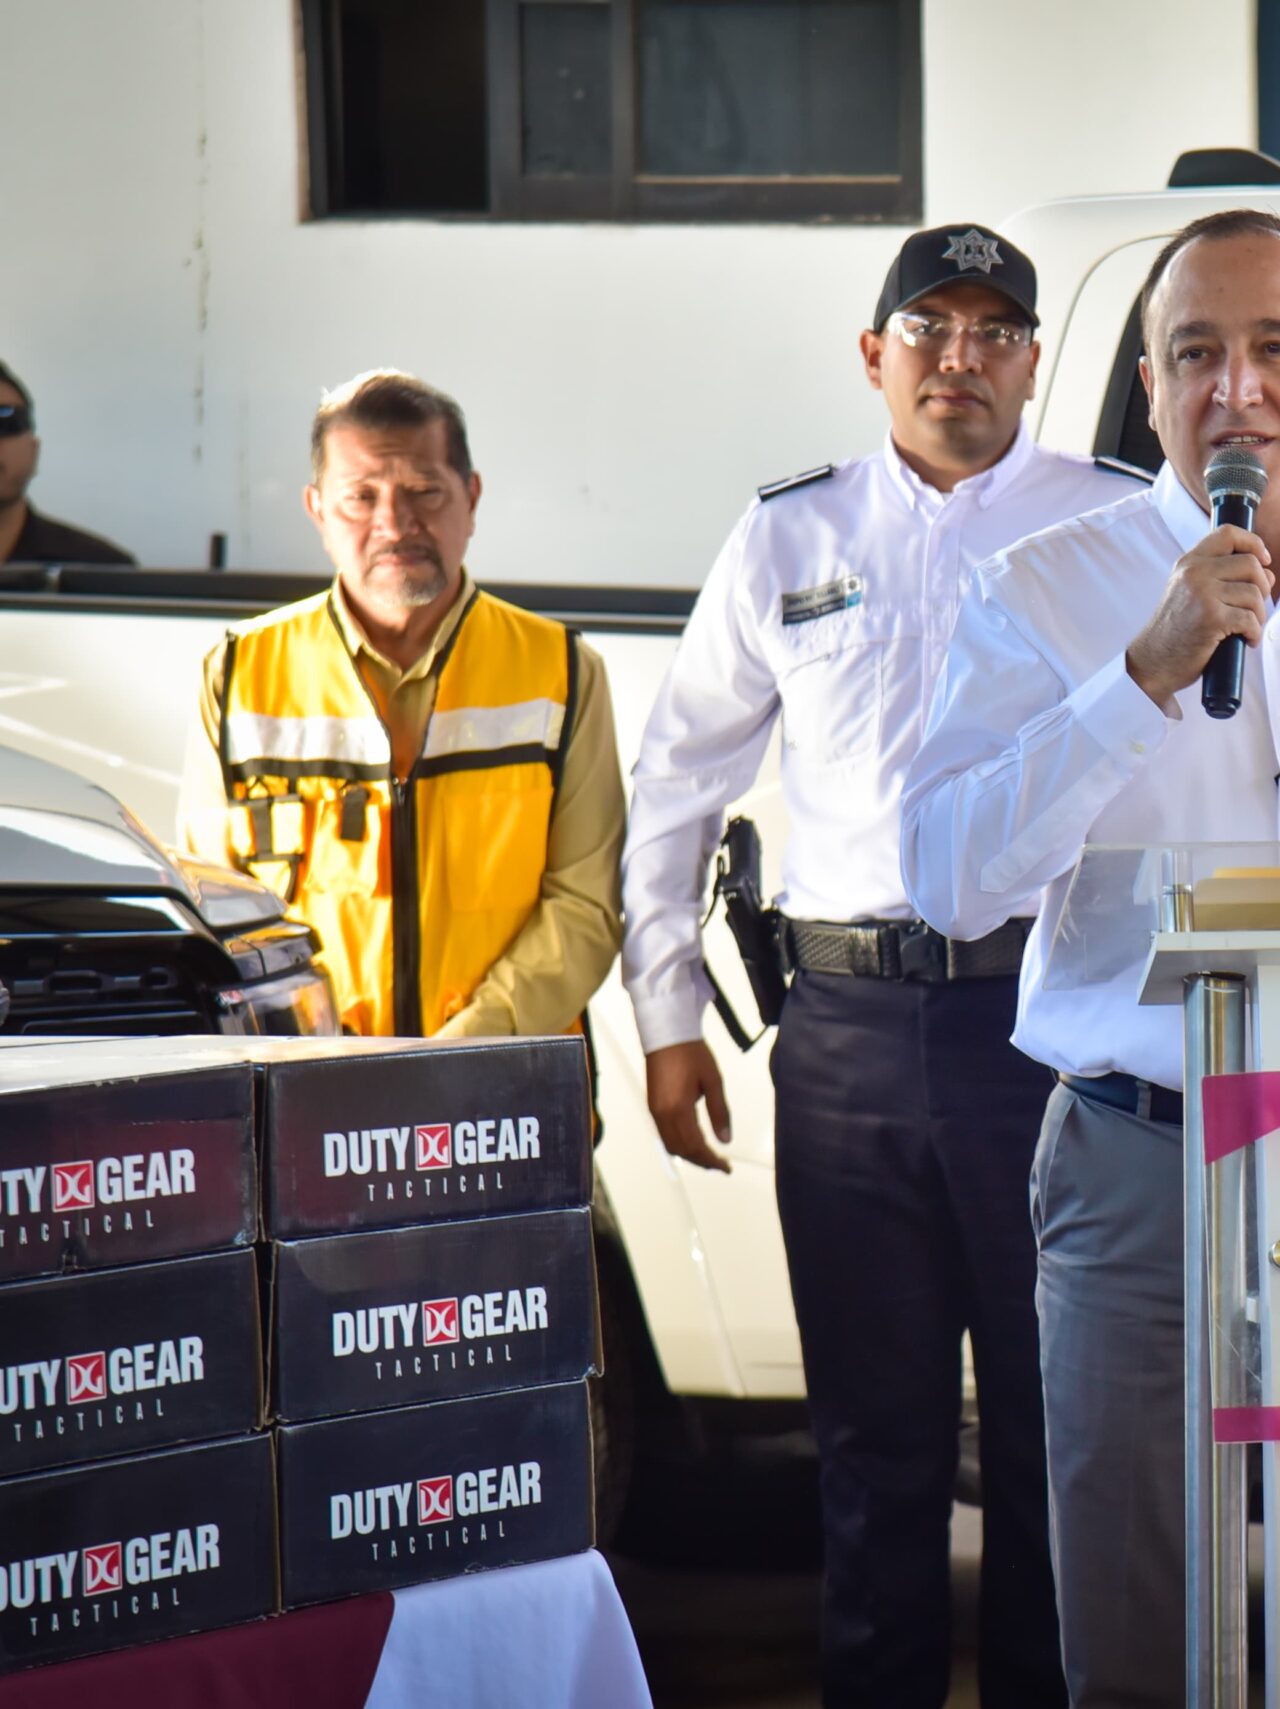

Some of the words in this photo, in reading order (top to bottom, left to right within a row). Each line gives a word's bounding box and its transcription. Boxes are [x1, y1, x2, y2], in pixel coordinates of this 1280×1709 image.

[323, 1126, 410, 1177] DUTY
[454, 1116, 540, 1166] GEAR
[0, 1166, 46, 1216] TY
[97, 1149, 196, 1204] GEAR
[368, 1172, 503, 1202] TACTICAL
[332, 1303, 418, 1357] DUTY
[461, 1287, 549, 1340] GEAR
[108, 1336, 204, 1395] GEAR
[375, 1344, 512, 1379] TACTICAL
[14, 1399, 163, 1442] TACTICAL
[330, 1482, 413, 1539] DUTY
[455, 1461, 541, 1517] GEAR
[125, 1523, 220, 1585] GEAR
[372, 1520, 505, 1560] TACTICAL
[30, 1587, 180, 1636] TACTICAL
